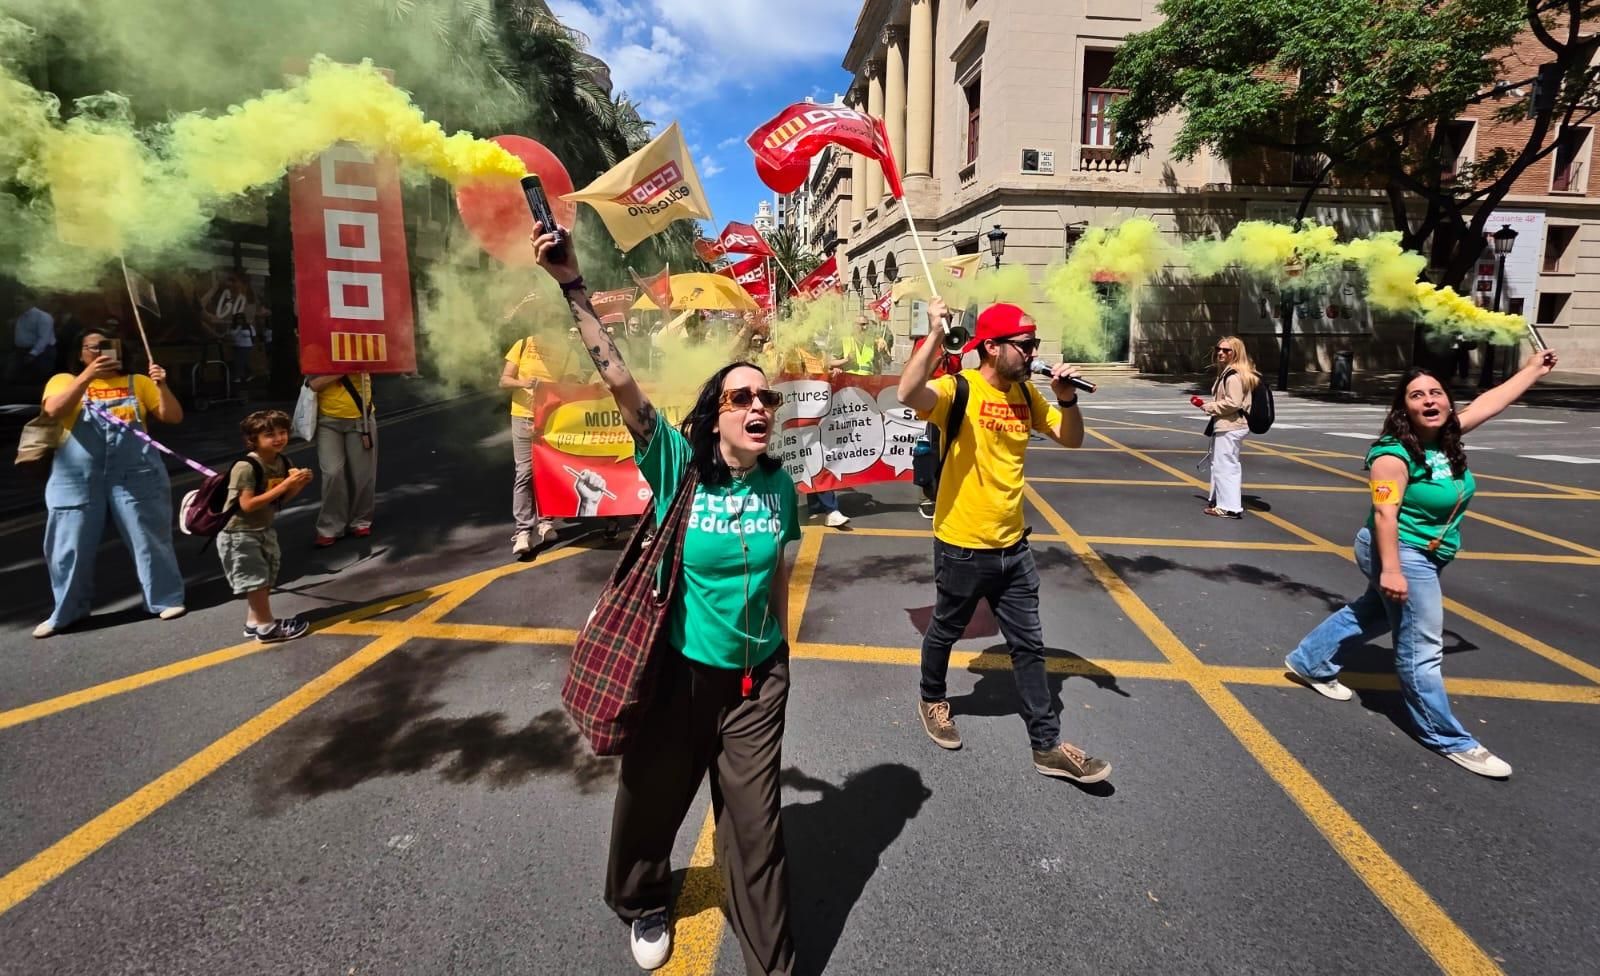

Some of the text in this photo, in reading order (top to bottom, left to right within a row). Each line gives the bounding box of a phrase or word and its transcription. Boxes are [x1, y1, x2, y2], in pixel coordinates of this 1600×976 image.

[828, 417, 872, 431] alumnat
[836, 433, 862, 445] molt
[799, 447, 812, 458] en
[826, 448, 876, 462] elevades
[890, 445, 905, 455] de
